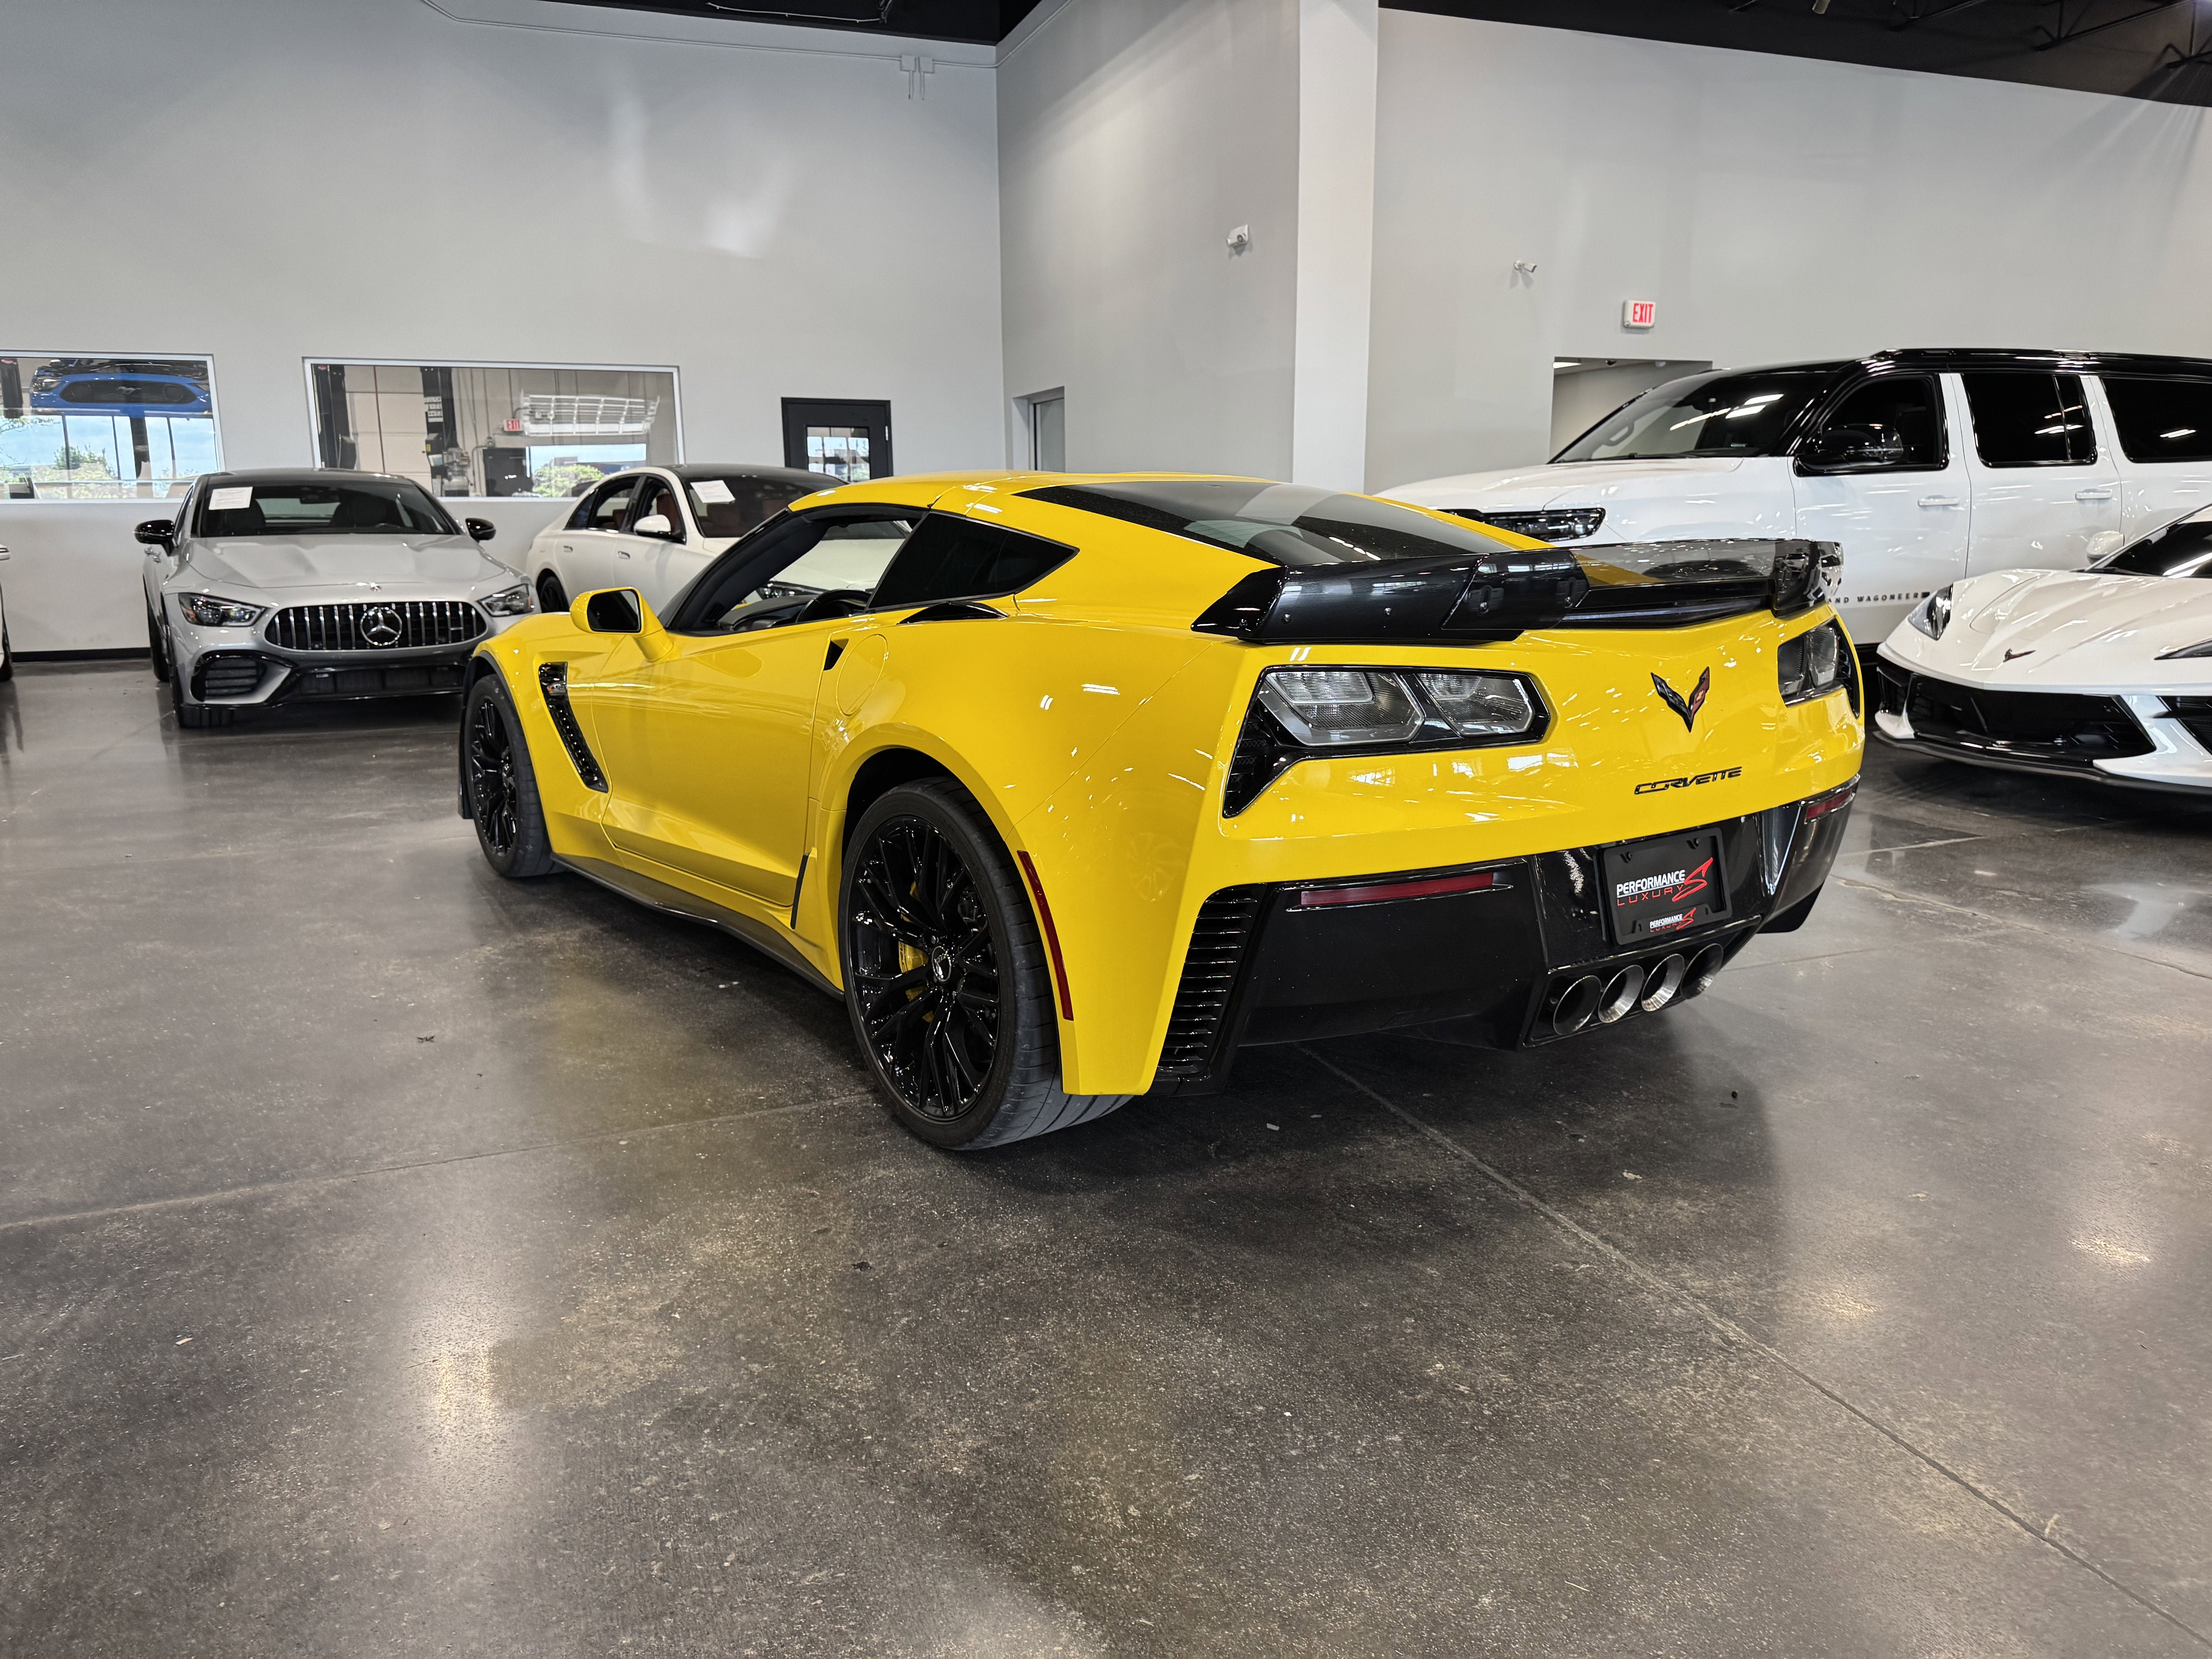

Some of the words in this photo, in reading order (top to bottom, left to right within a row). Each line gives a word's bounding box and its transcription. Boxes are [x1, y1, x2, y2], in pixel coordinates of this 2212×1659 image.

[1633, 303, 1653, 323] EXIT
[1857, 592, 1918, 602] WAGONEER
[1634, 766, 1742, 795] CORVETTE
[1616, 869, 1685, 896] PERFORMANCE
[1617, 884, 1683, 906] LUXURY
[1649, 914, 1683, 929] PERFORMANCE
